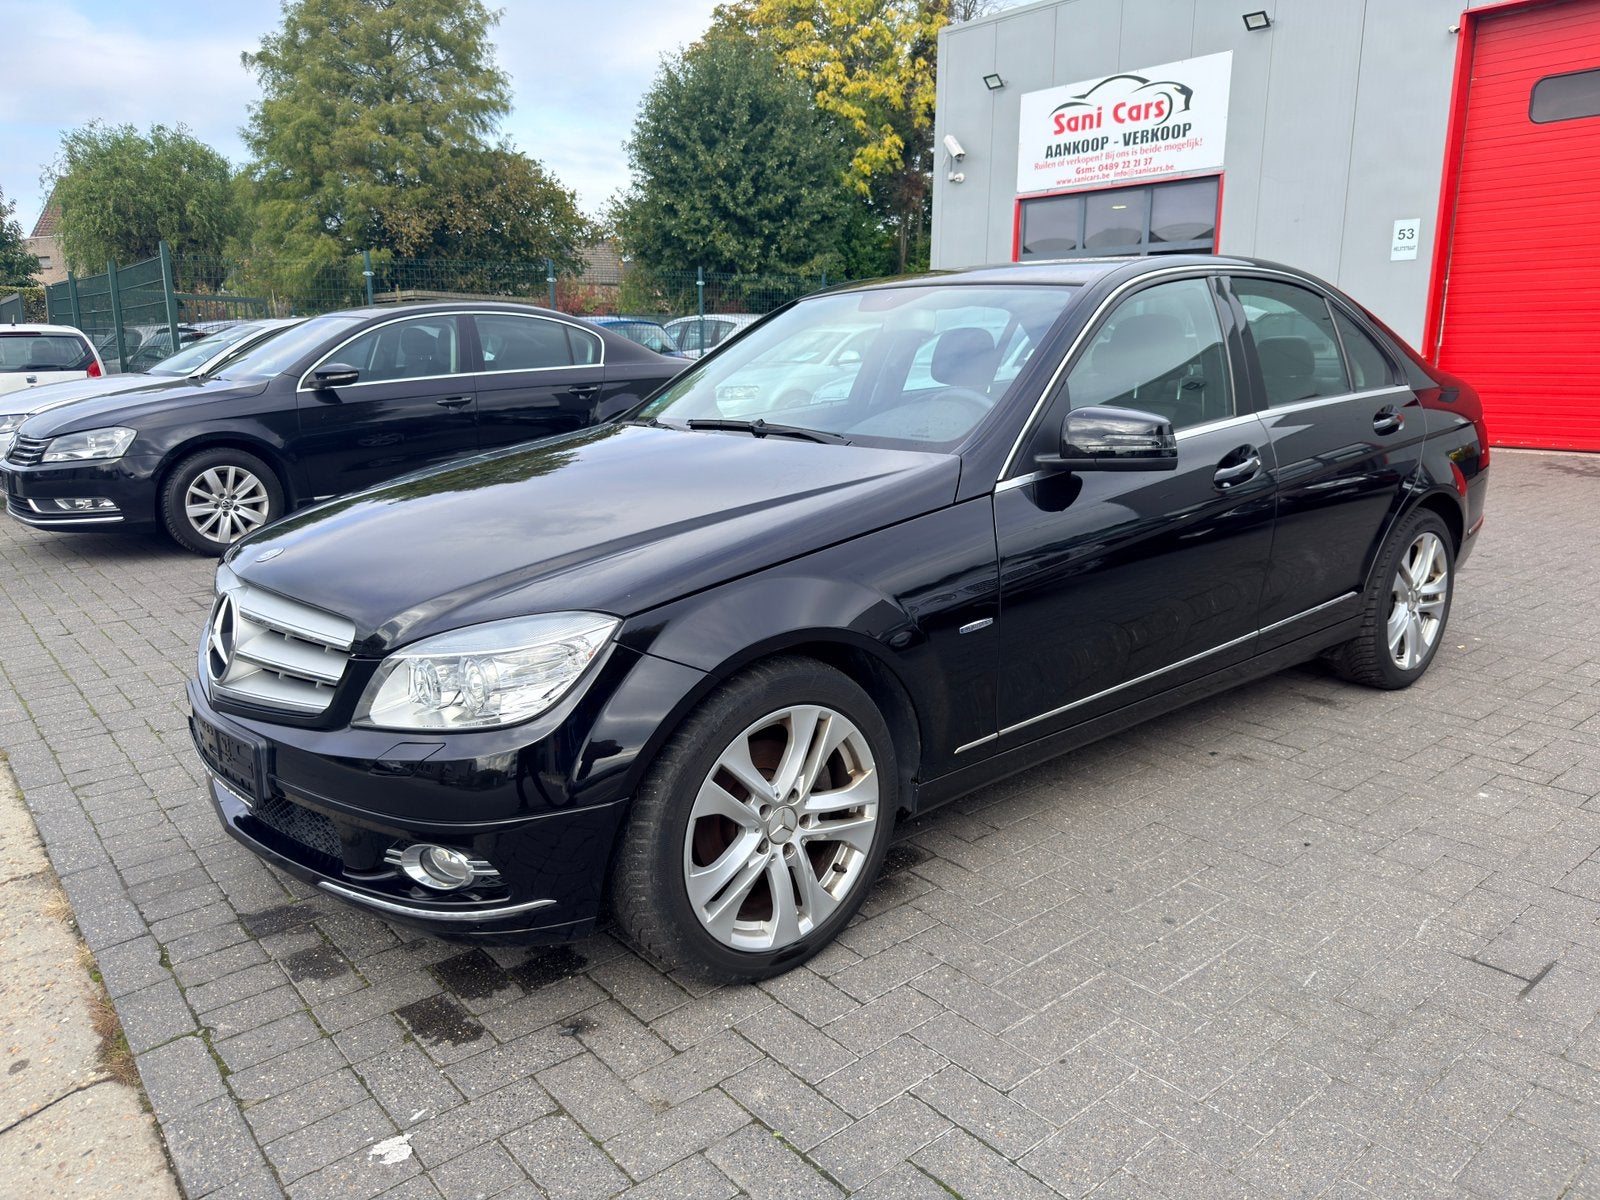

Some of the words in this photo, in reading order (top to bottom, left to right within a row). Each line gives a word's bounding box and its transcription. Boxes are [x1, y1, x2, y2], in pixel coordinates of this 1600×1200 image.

[1053, 106, 1102, 135] Sani
[1113, 99, 1165, 124] Cars
[1045, 136, 1109, 159] AANKOOP
[1123, 122, 1192, 147] VERKOOP
[1034, 161, 1056, 170] Ruilen
[1057, 158, 1065, 167] of
[1105, 151, 1115, 161] Bij
[1116, 150, 1129, 158] ons
[1131, 147, 1138, 156] is
[1139, 144, 1162, 154] beide
[1164, 138, 1203, 152] mogelijk!
[1075, 166, 1095, 174] Gsm:
[1098, 162, 1119, 172] 0489
[1122, 160, 1131, 169] 22
[1133, 159, 1141, 167] 21
[1143, 157, 1153, 166] 37
[1056, 173, 1110, 185] www.sanicars.be
[1113, 164, 1174, 177] info@sanicars.be
[1397, 227, 1415, 241] 53
